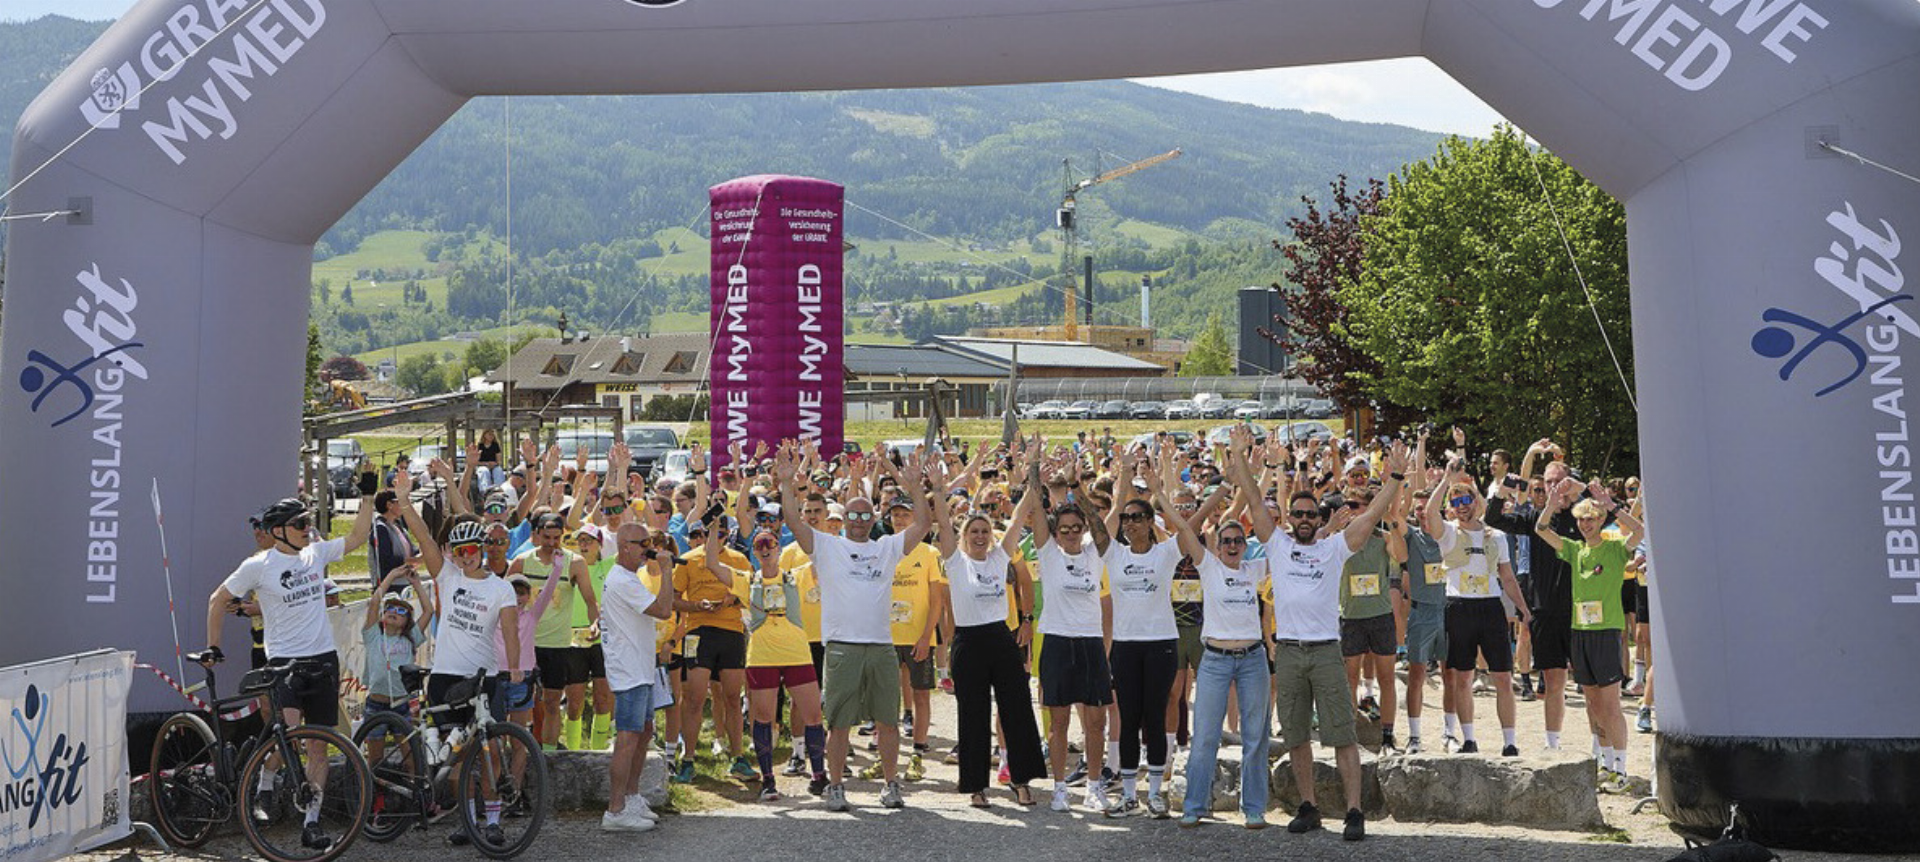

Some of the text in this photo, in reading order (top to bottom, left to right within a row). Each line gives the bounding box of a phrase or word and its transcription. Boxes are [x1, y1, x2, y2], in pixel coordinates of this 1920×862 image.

[142, 0, 326, 165] MyMED
[727, 264, 752, 381] MyMED
[798, 263, 828, 382] MyMED
[605, 383, 638, 393] WEISS
[0, 733, 90, 829] NG fit
